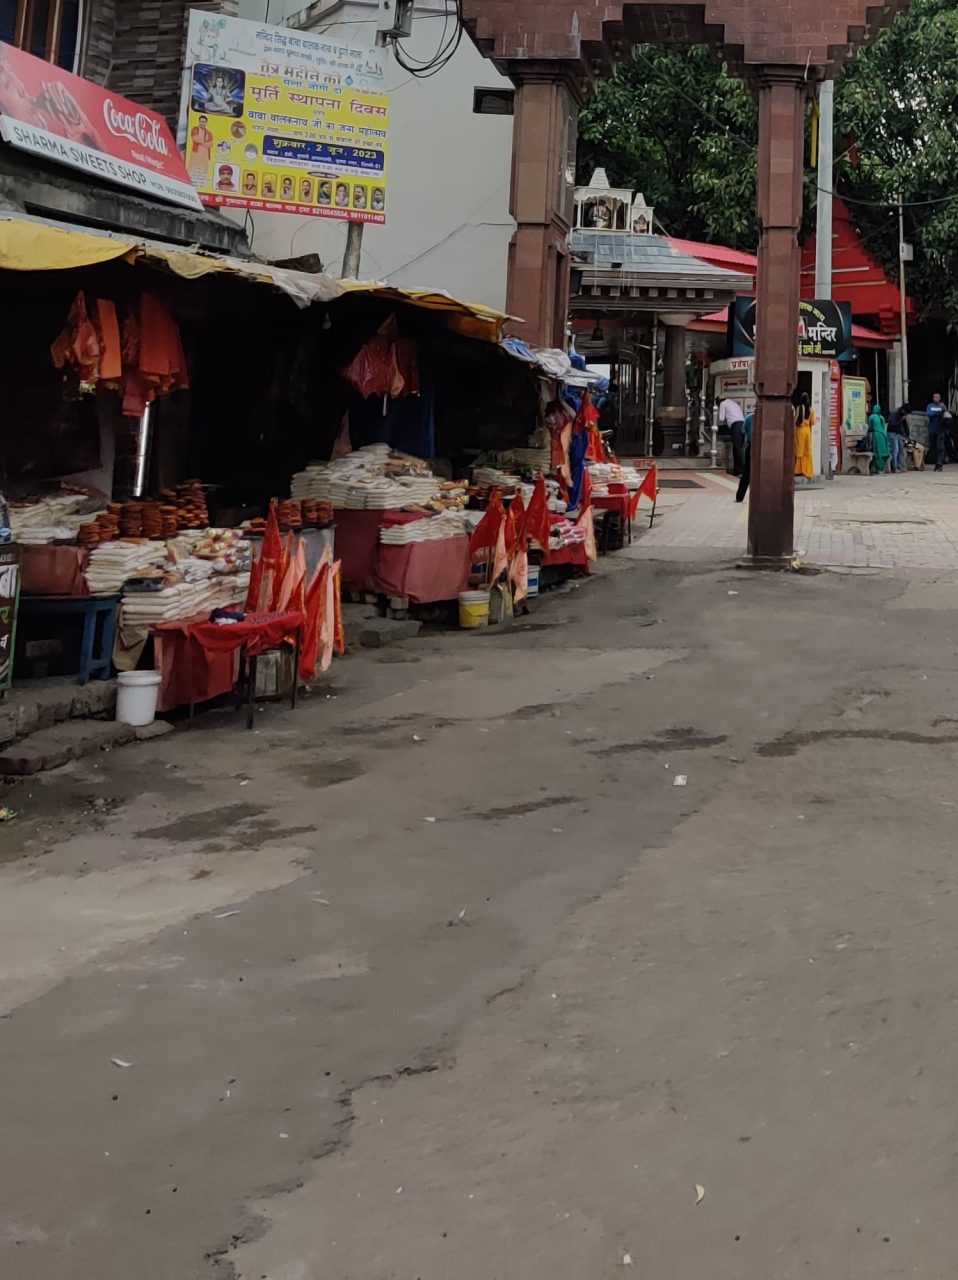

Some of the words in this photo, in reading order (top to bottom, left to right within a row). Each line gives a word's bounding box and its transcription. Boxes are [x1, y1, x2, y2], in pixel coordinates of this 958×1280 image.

[250, 85, 280, 102] मूर्ति
[288, 92, 342, 111] स्थापना
[349, 99, 389, 117] दिवस
[103, 99, 168, 156] Coca-Cola
[358, 125, 387, 138] महोत्सव
[13, 126, 67, 157] SHARMA
[71, 147, 118, 177] SWEETS
[118, 165, 147, 185] SHOP
[315, 144, 322, 152] 2
[352, 148, 377, 159] 2023
[808, 322, 837, 342] मन्दिर
